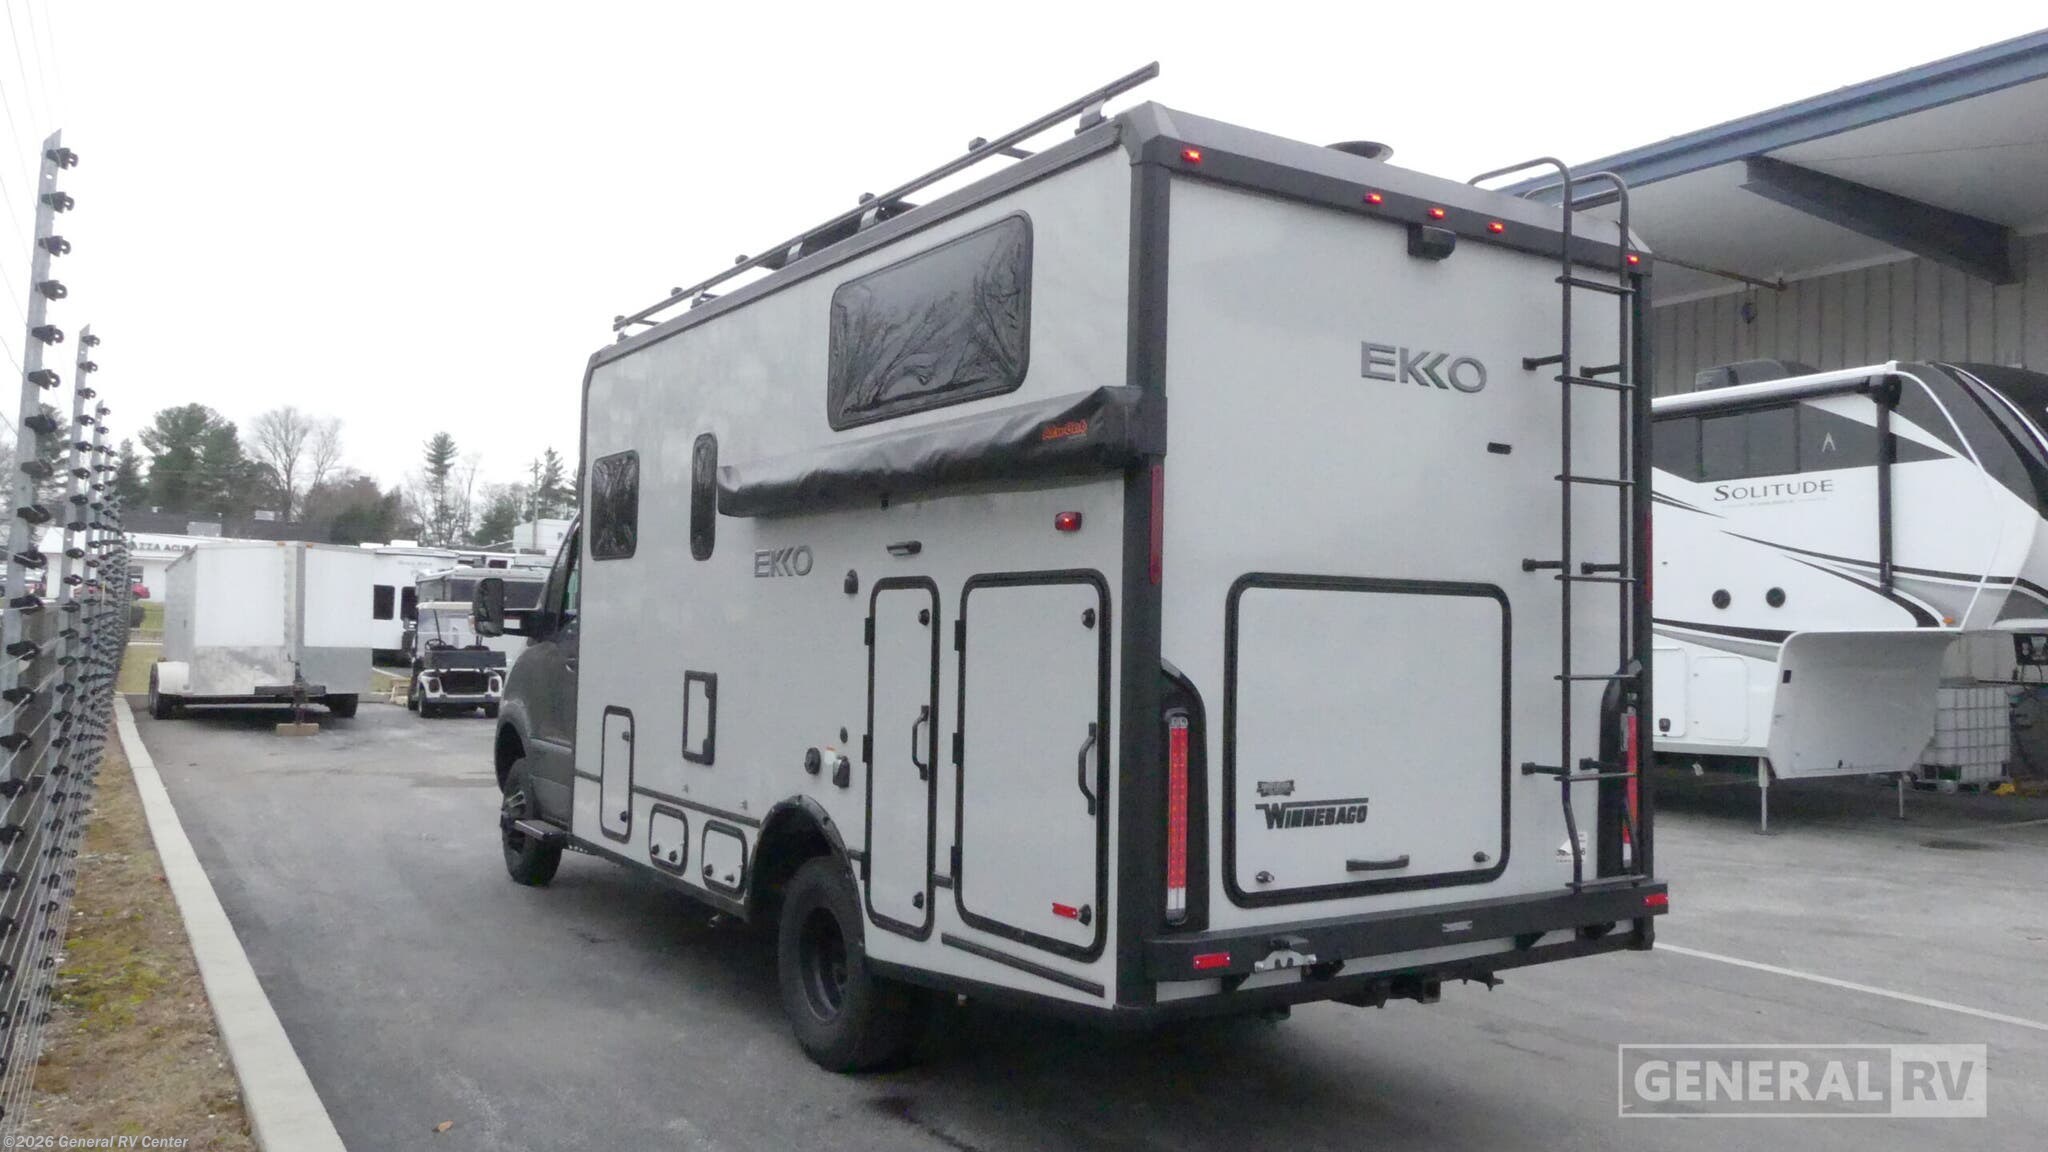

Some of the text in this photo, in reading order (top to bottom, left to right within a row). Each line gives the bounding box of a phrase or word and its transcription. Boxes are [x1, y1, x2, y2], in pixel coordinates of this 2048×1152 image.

[1360, 340, 1488, 393] EKKO
[1713, 479, 1834, 502] SOLITUDE
[754, 545, 814, 578] EKKO
[1255, 797, 1369, 830] WINNEBAGO
